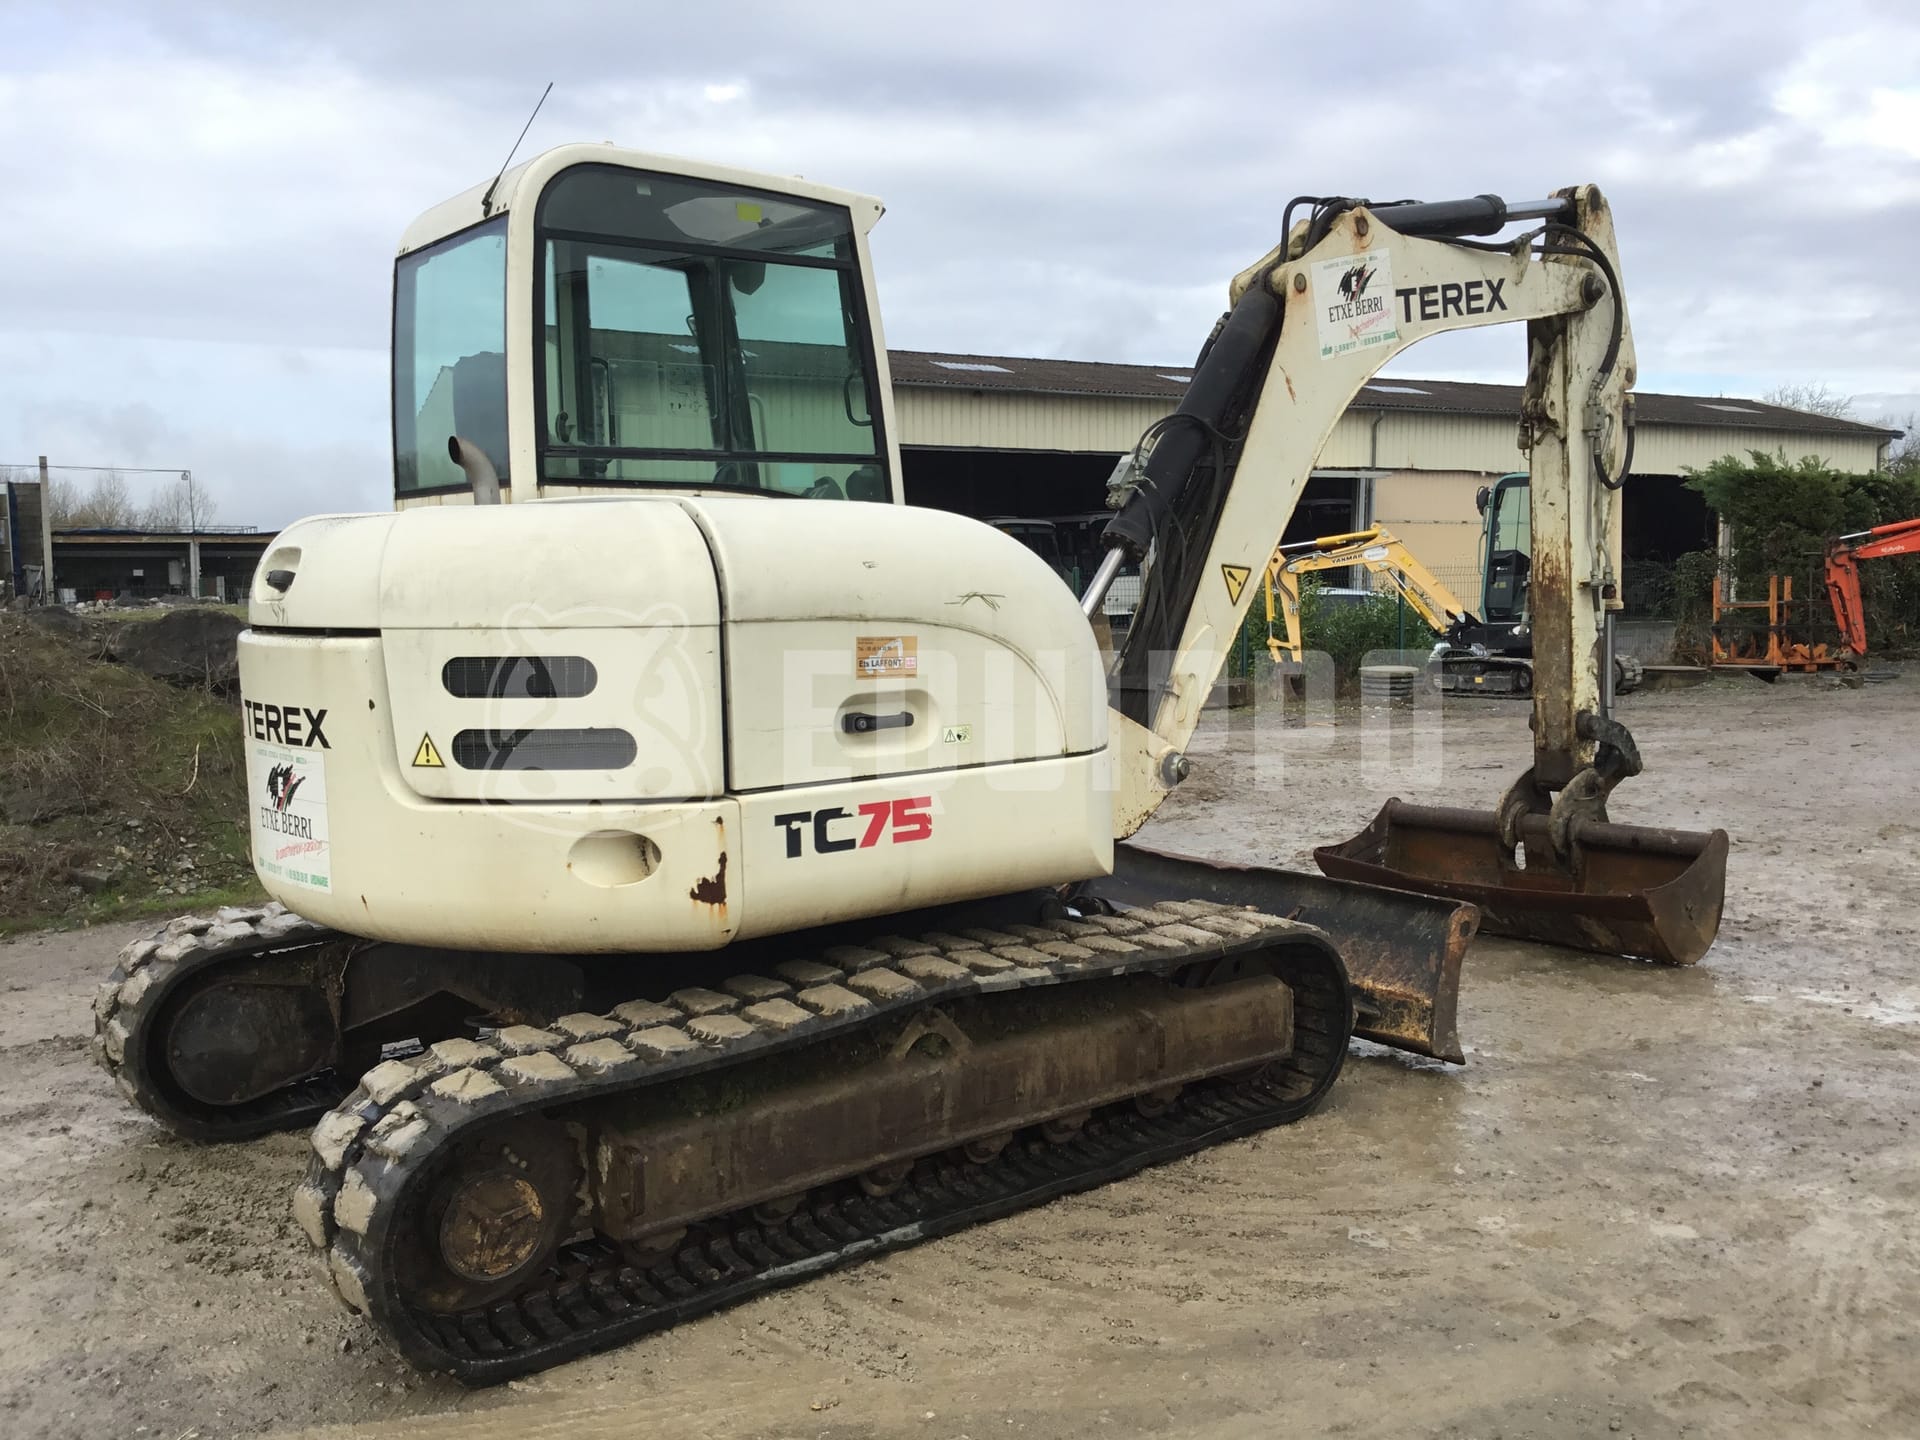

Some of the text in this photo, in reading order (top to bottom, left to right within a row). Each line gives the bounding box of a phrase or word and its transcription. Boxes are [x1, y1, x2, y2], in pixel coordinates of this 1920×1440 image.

[1329, 300, 1354, 323] ETXE
[1355, 296, 1384, 317] BERRI
[1396, 278, 1508, 323] TEREX
[1332, 553, 1363, 564] YANMAR
[244, 699, 332, 749] TEREX
[261, 806, 312, 840] ETXE BERRI
[774, 796, 932, 858] TC75
